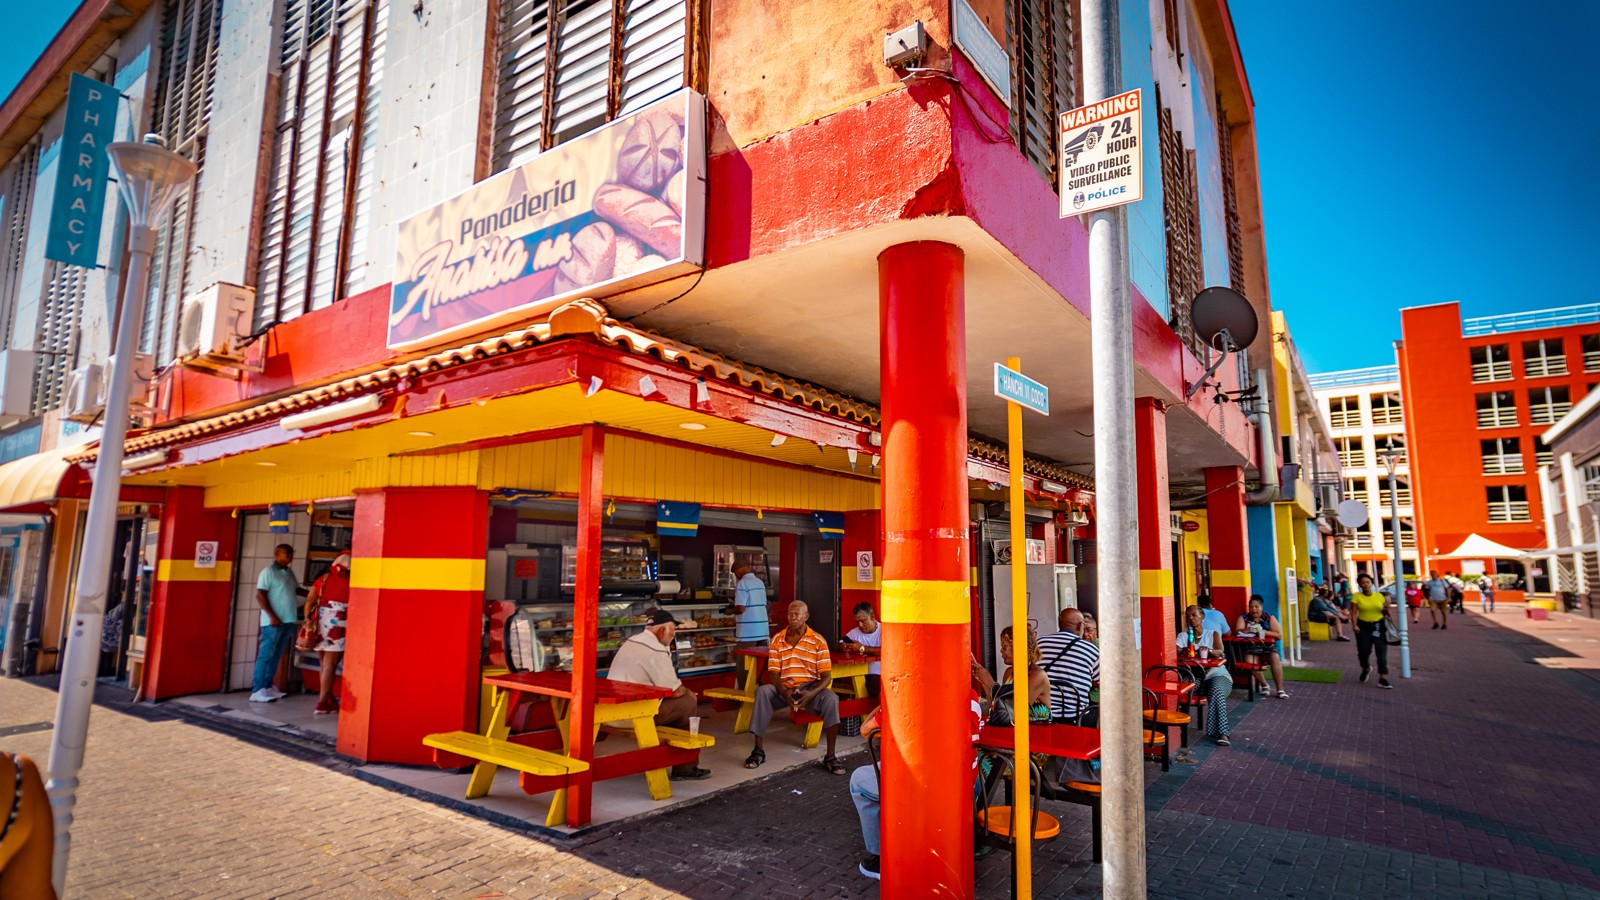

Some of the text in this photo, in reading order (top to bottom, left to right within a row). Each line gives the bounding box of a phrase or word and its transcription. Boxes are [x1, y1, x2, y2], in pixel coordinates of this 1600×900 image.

[1062, 93, 1139, 130] WARNING
[1111, 116, 1132, 139] 24
[1106, 136, 1137, 154] HOUR
[67, 89, 102, 256] PHARMACY
[1068, 165, 1132, 191] SURVEILLANCE
[1070, 154, 1130, 178] VIDEO PUBLIC
[1087, 185, 1127, 201] POLICE
[459, 178, 576, 246] Panaderia
